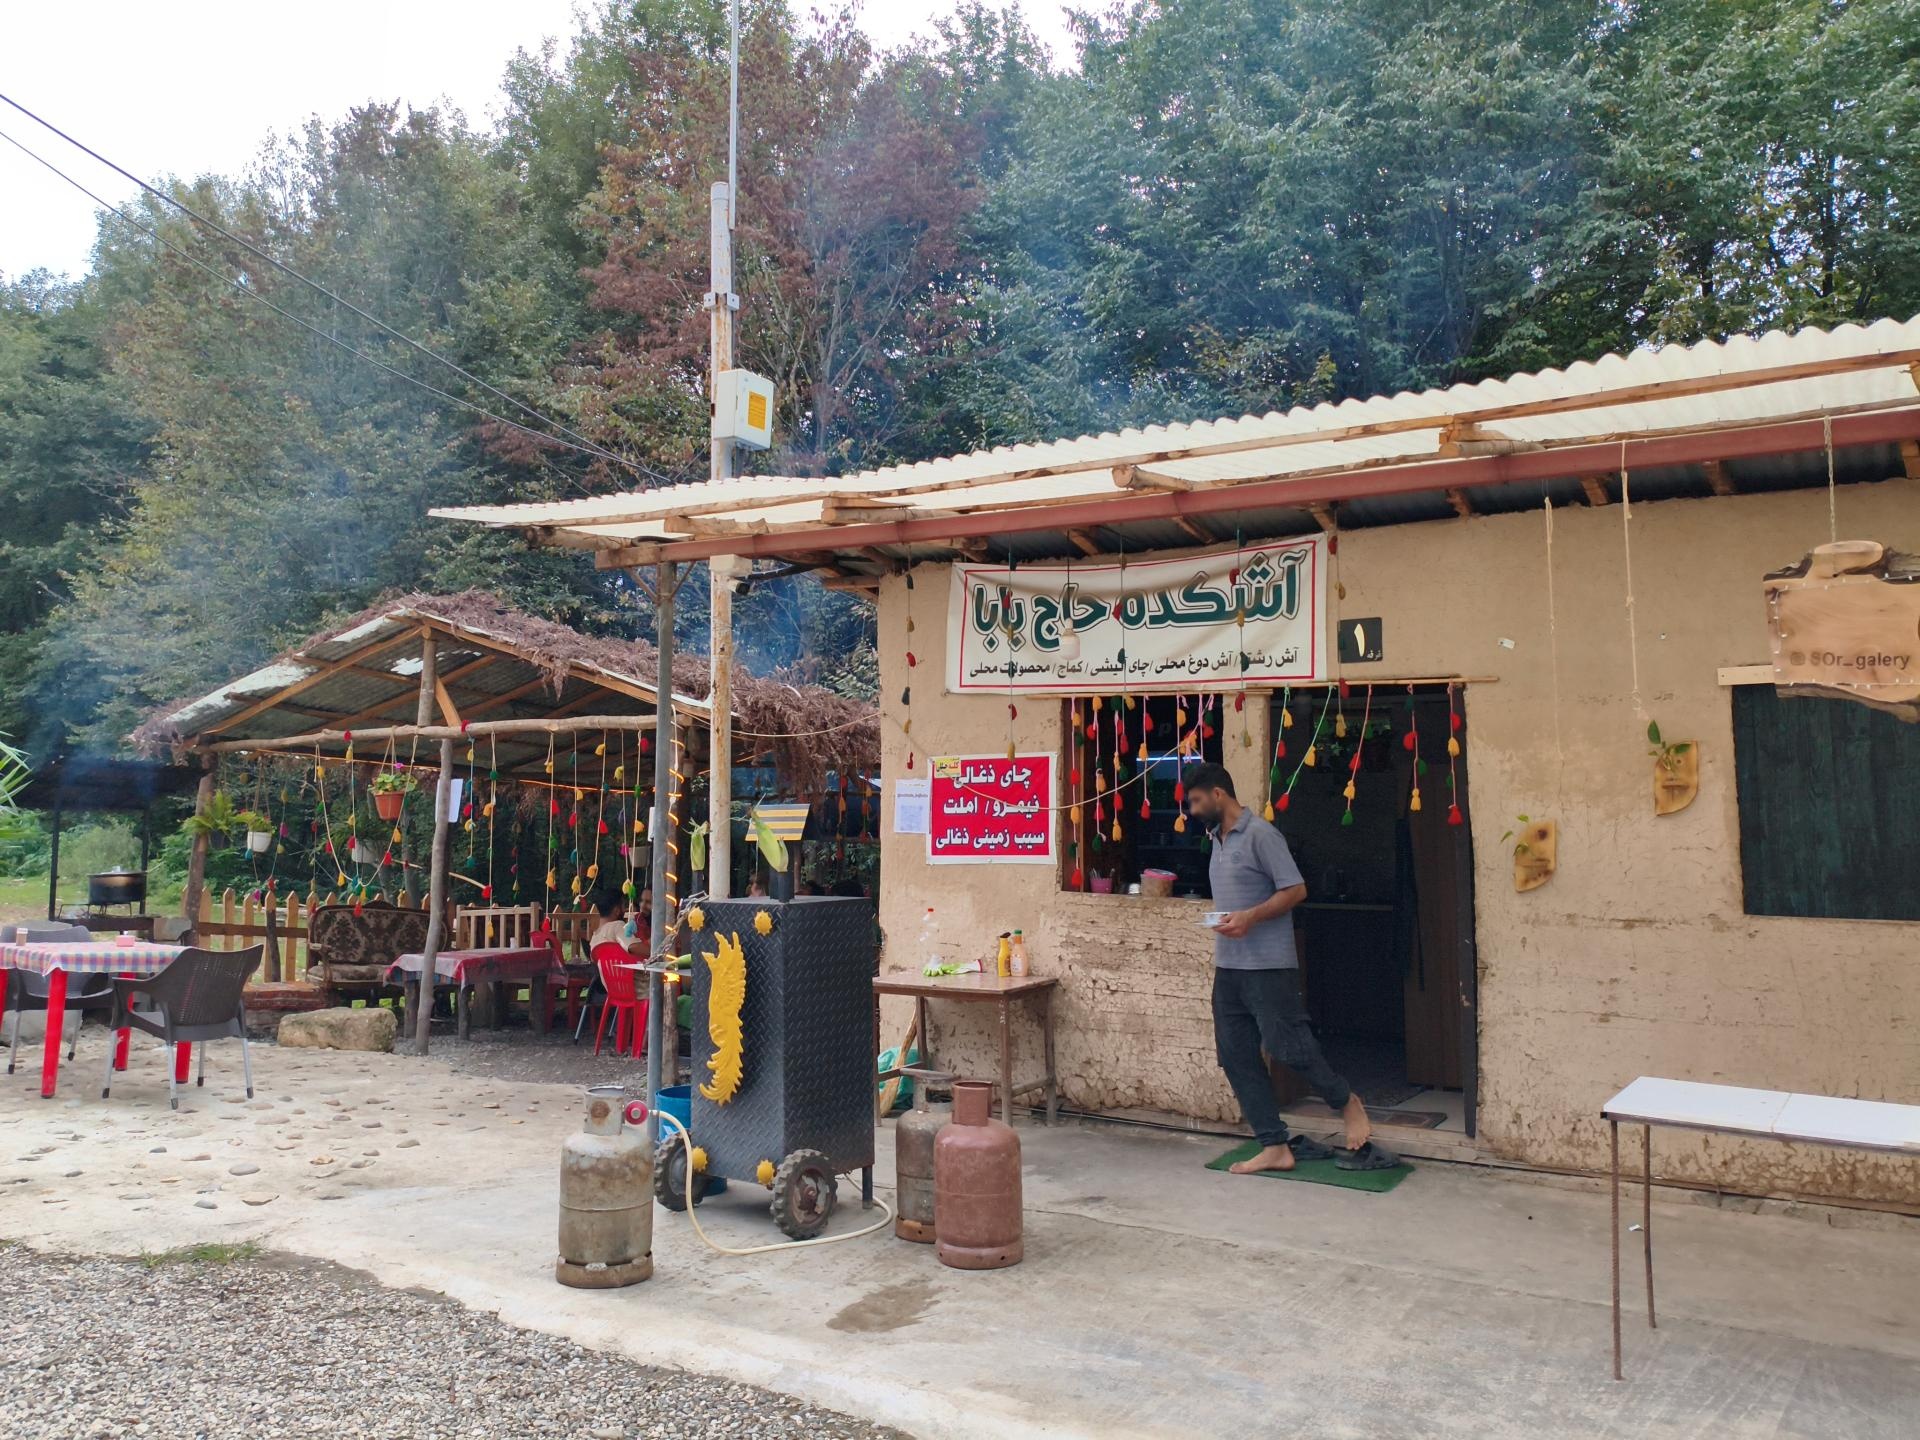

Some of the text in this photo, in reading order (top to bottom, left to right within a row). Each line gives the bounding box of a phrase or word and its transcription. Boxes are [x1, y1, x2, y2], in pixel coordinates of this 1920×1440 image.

[972, 549, 1307, 653] آشکده حاج بابا
[1155, 657, 1186, 674] محلی
[1188, 654, 1209, 675] دوغ
[1211, 651, 1234, 671] آش
[1242, 649, 1273, 668] رشت
[1275, 647, 1299, 668] آش
[970, 661, 998, 677] محلی
[1057, 660, 1083, 679] کماج
[953, 764, 995, 789] ذغالی
[1000, 763, 1032, 789] چای
[943, 796, 978, 815] املت
[992, 794, 1040, 818] نیمرو
[936, 827, 1045, 849] سیب زمینی ذغالی
